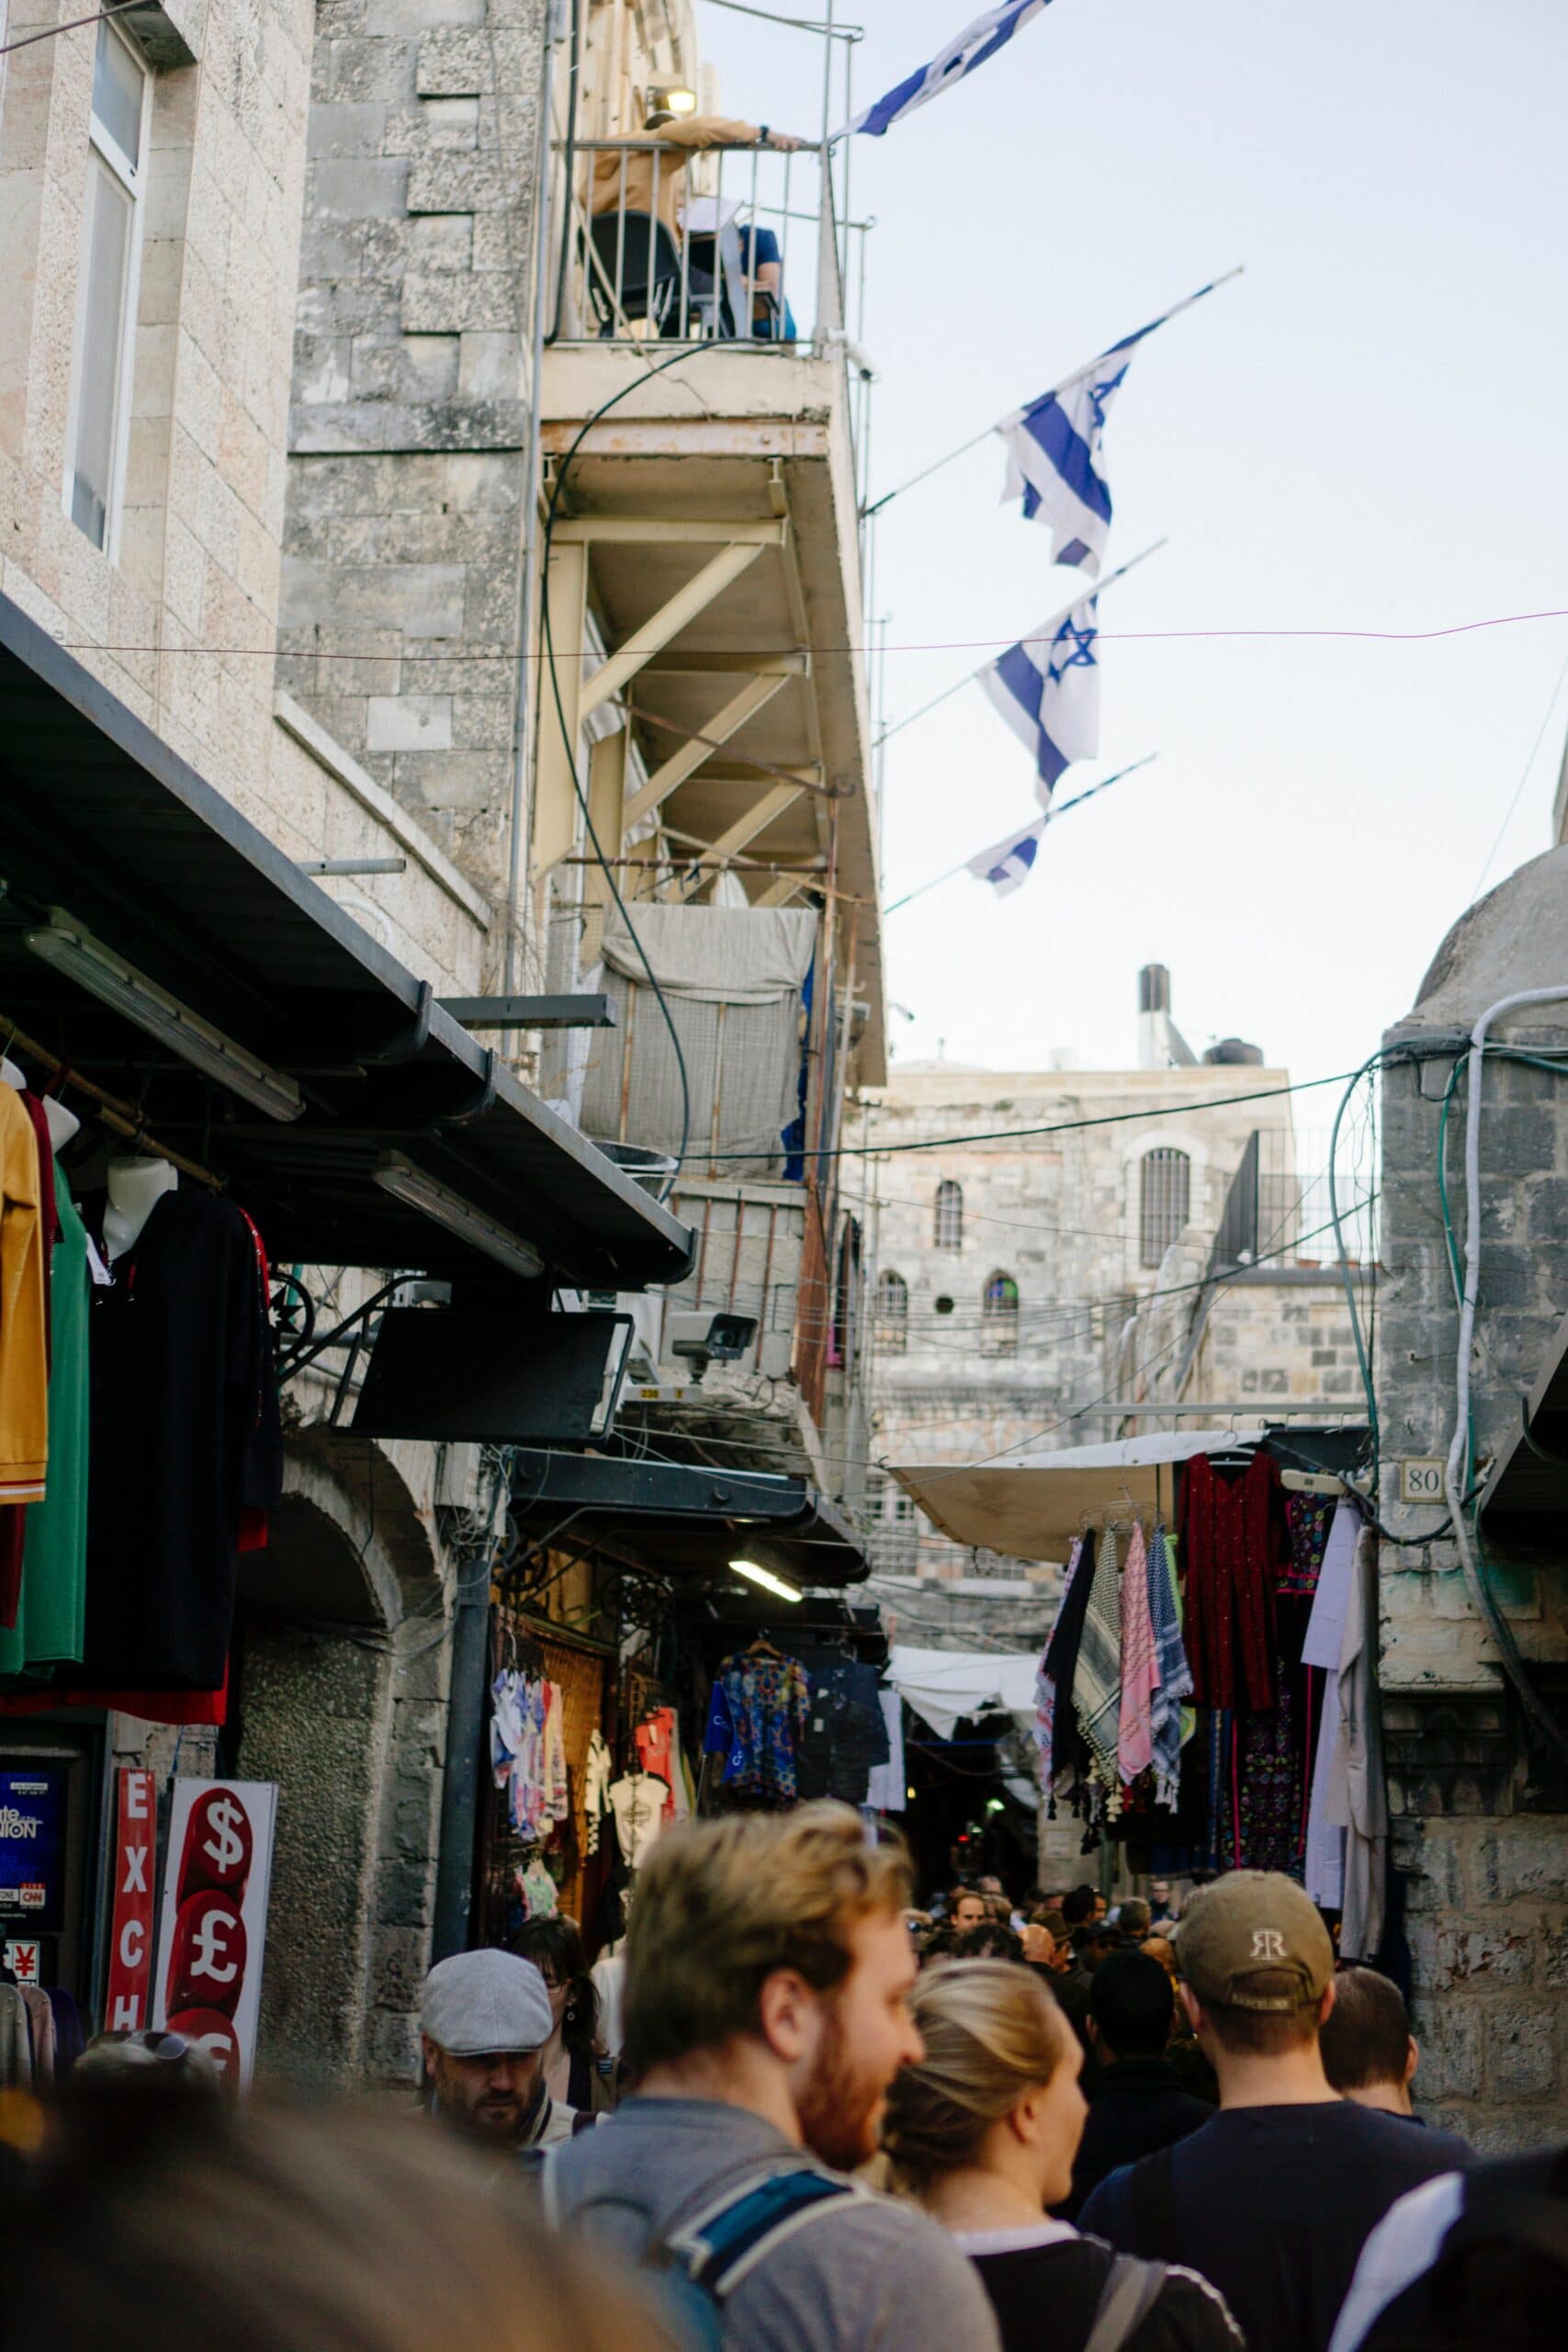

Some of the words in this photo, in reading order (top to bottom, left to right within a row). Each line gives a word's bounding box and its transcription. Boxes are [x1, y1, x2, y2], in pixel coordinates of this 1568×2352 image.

[1409, 1469, 1439, 1492] 80
[202, 1798, 243, 1874] $
[22, 1891, 42, 1902] CNN
[190, 1909, 237, 1984] £
